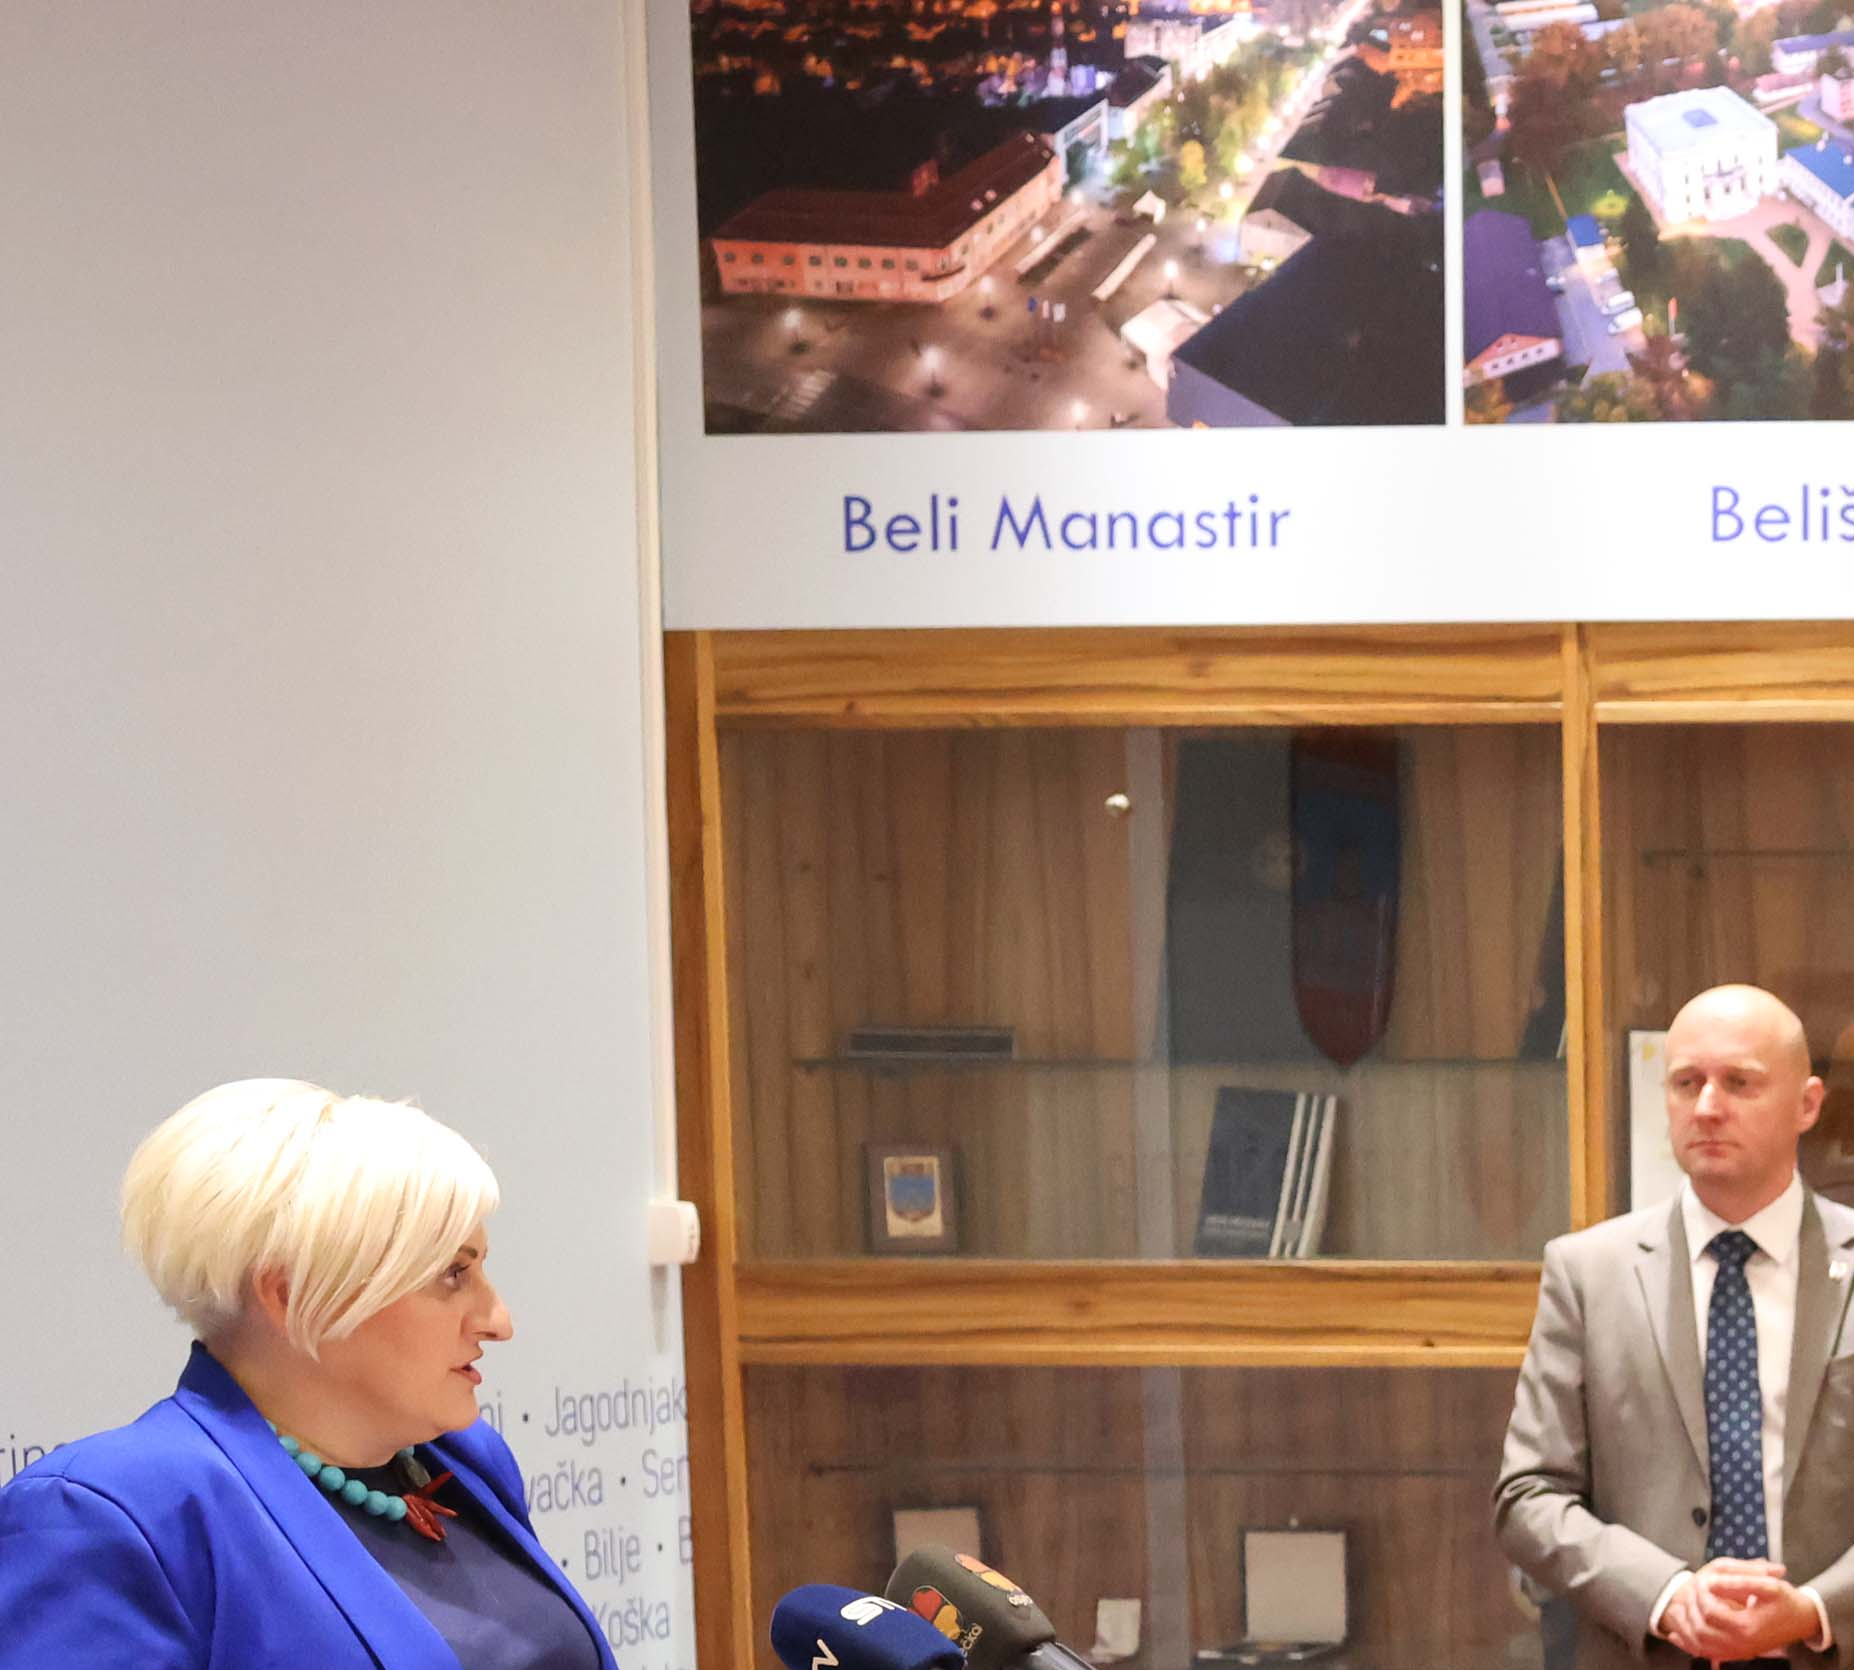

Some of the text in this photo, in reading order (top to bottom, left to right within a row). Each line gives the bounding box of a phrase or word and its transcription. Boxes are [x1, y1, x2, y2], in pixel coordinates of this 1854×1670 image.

[843, 493, 1293, 555] Beli Manastir
[527, 1459, 604, 1513] vačka
[584, 1526, 642, 1586] Bilje
